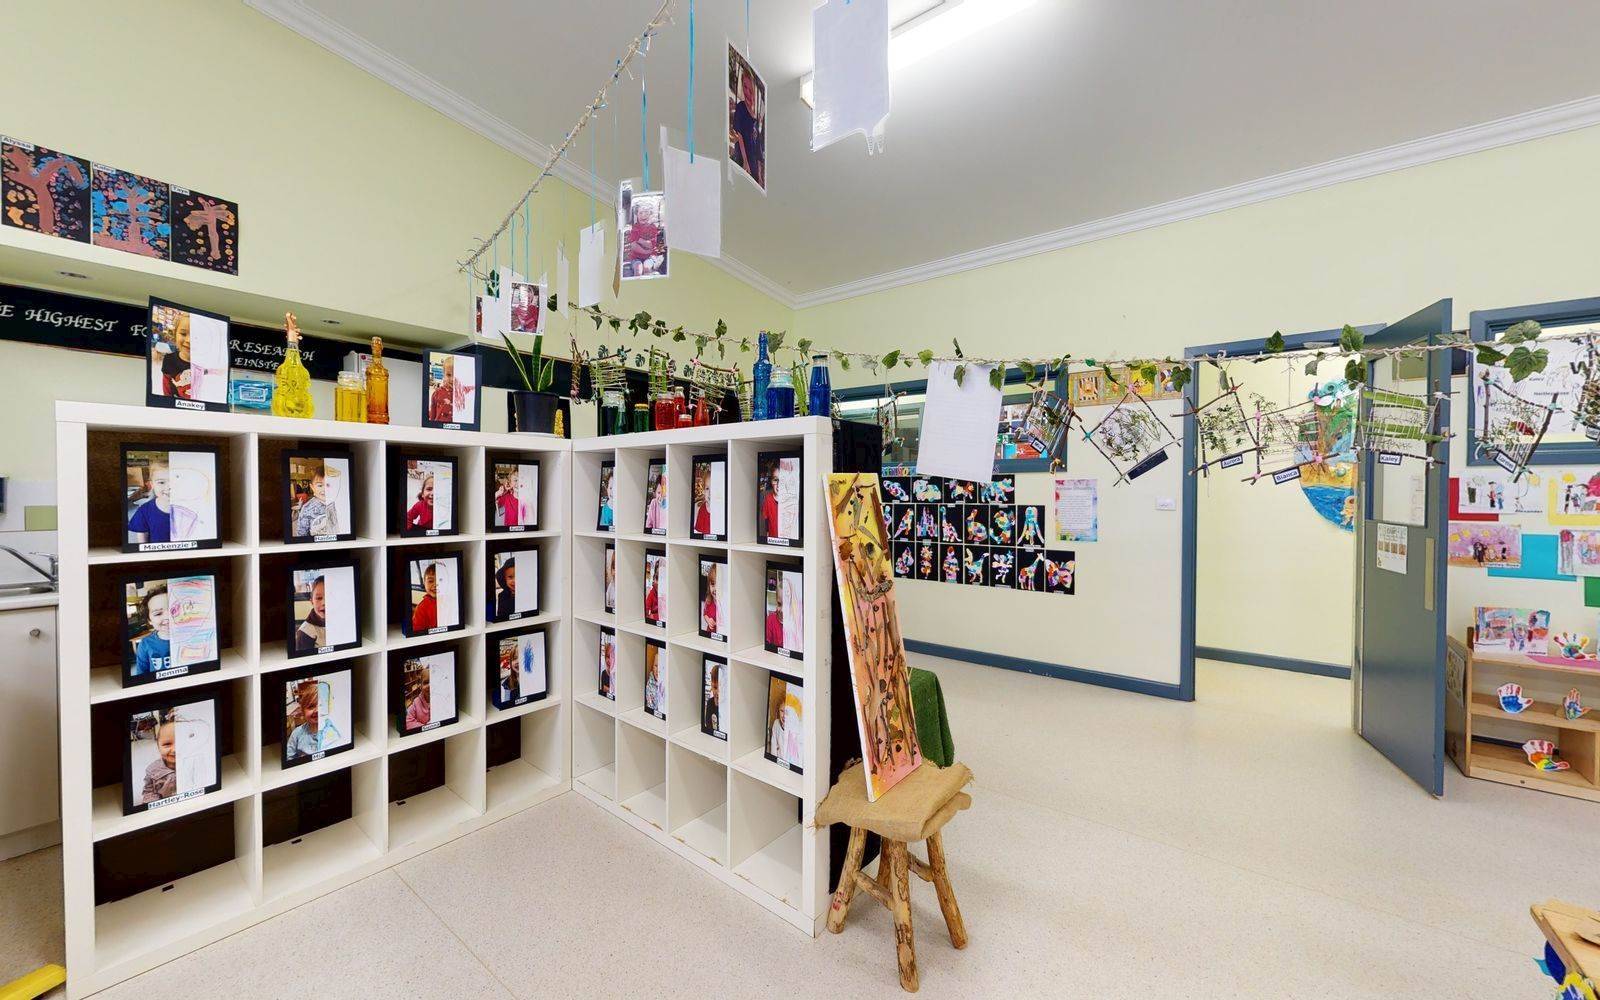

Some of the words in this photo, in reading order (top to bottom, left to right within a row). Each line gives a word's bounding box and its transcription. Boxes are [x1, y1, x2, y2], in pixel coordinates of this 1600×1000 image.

[25, 309, 118, 332] HIGHEST
[1223, 456, 1241, 467] Aurora
[1380, 455, 1399, 463] Kaley
[1276, 470, 1298, 482] Bianca
[143, 542, 189, 551] Mackenzie
[191, 540, 198, 548] P
[157, 667, 188, 679] Jemma
[148, 788, 205, 809] Hartley-Rose
